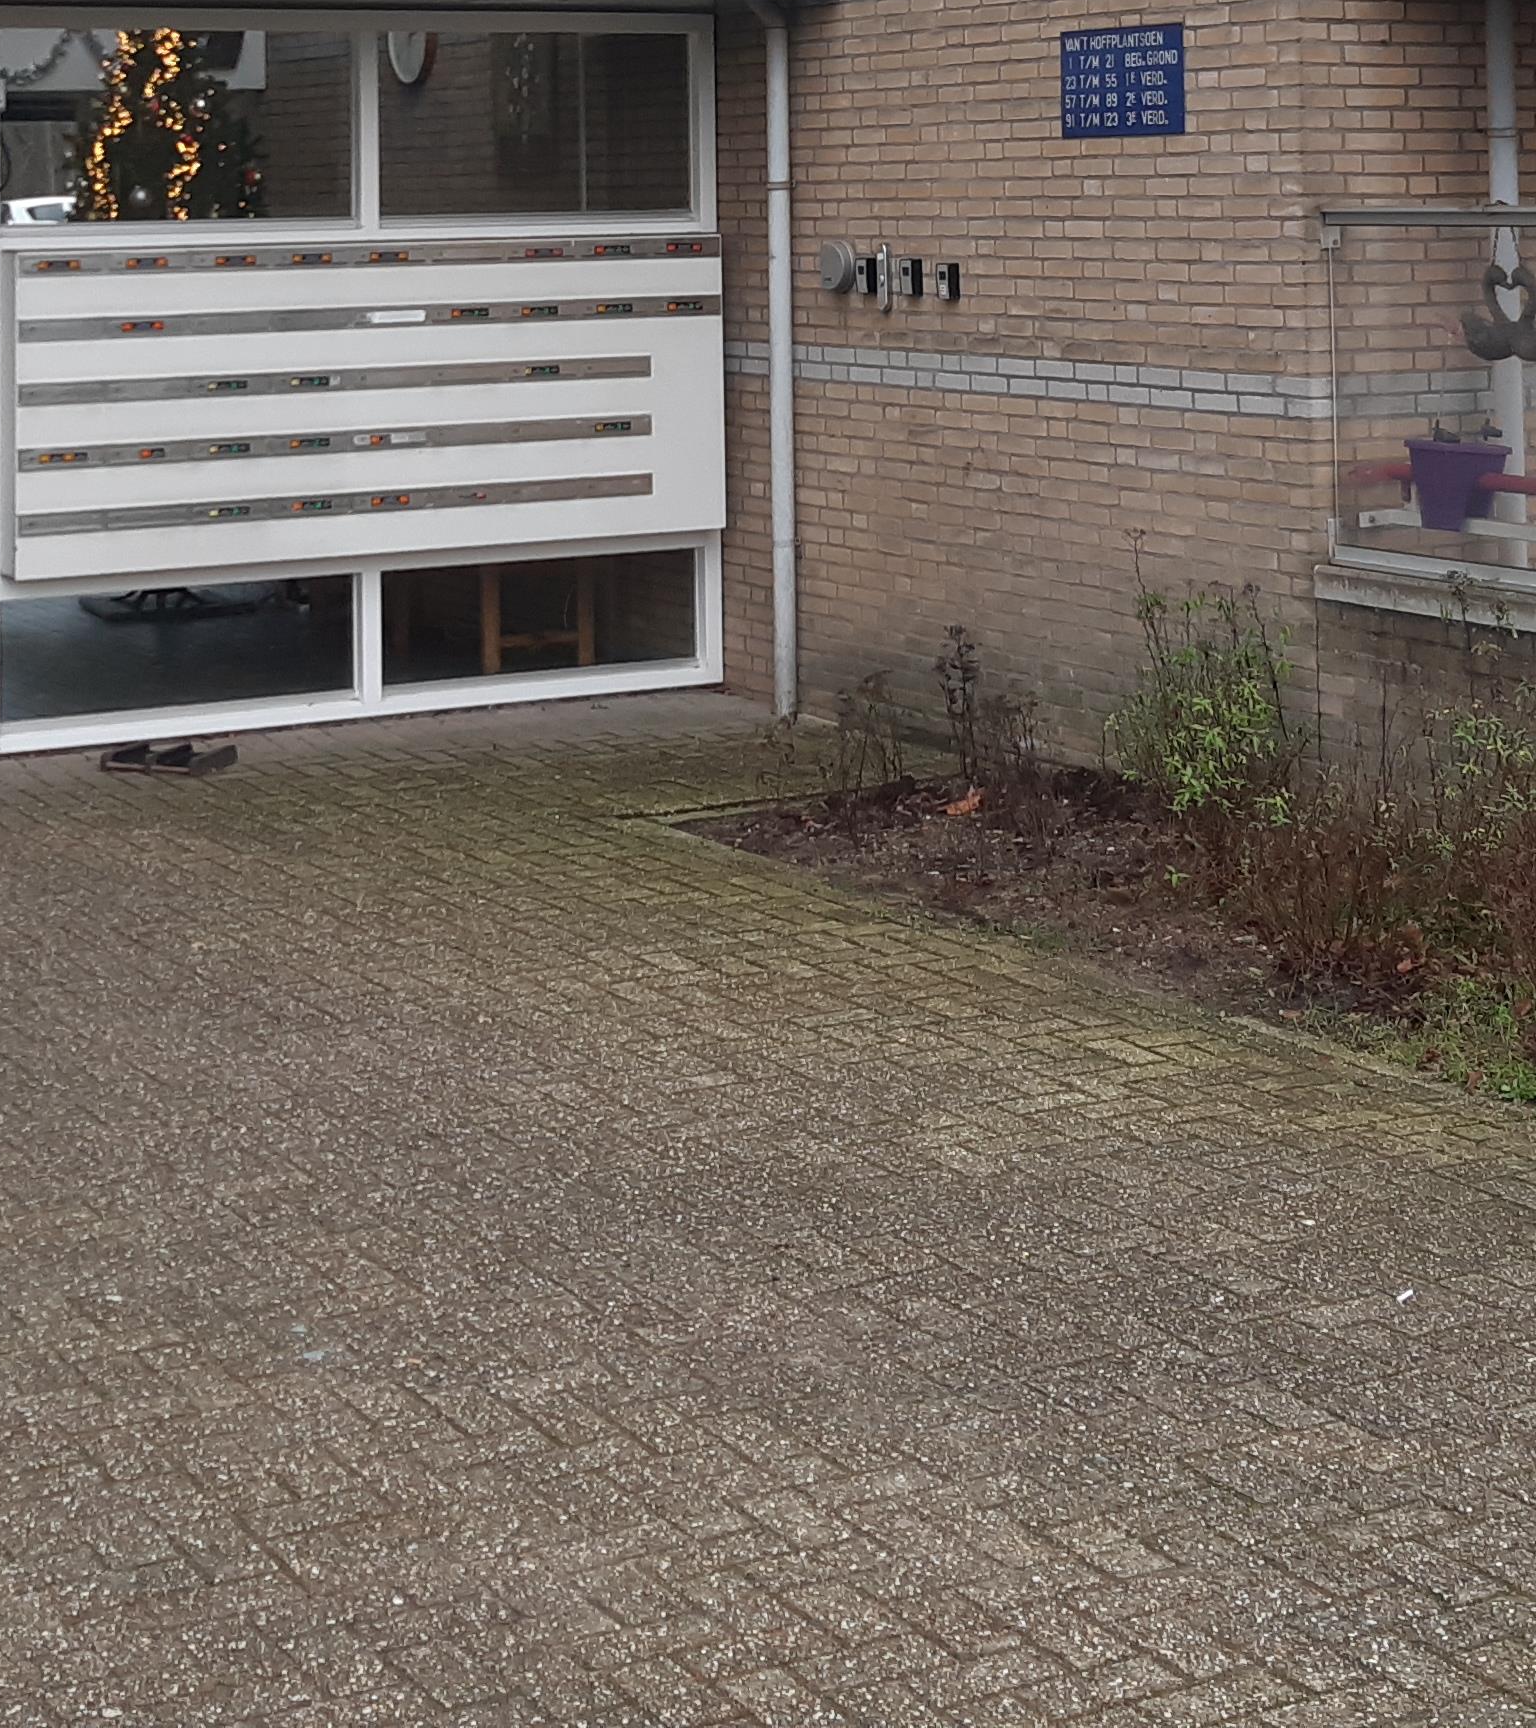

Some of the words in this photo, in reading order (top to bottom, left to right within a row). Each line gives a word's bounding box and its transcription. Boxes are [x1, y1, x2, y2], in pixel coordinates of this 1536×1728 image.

[1090, 31, 1163, 50] HOFFPLANTSOEN
[1079, 55, 1099, 69] T/M
[1105, 54, 1114, 68] 21
[1065, 76, 1076, 90] 23
[1080, 74, 1099, 88] T/M
[1105, 74, 1117, 88] 55
[1140, 71, 1167, 86] VERD.
[1065, 95, 1076, 109] 57
[1080, 94, 1100, 108] T/M
[1106, 93, 1118, 107] 89
[1141, 91, 1168, 106] VERD.
[1065, 114, 1075, 128] 91
[1080, 113, 1100, 127] T/M
[1104, 112, 1118, 127] 123
[1141, 110, 1168, 125] VERD.
